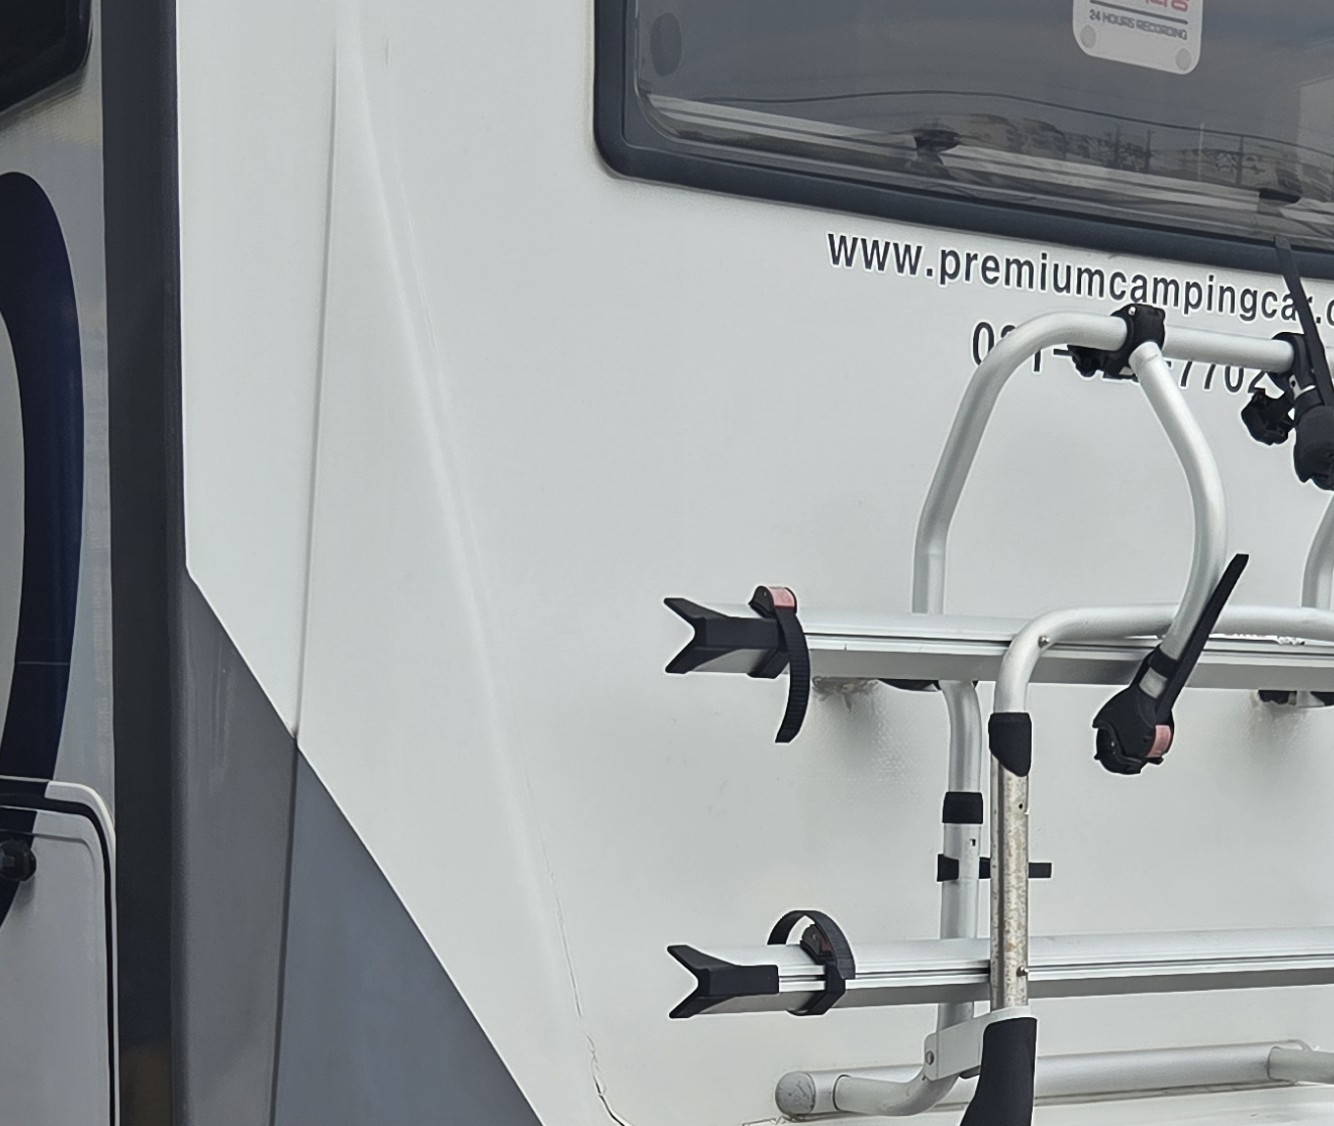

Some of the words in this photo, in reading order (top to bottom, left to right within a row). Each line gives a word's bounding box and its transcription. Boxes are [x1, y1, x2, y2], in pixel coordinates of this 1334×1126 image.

[1089, 8, 1101, 21] 24
[1102, 12, 1135, 29] HOURS
[1135, 20, 1188, 41] RECORDING
